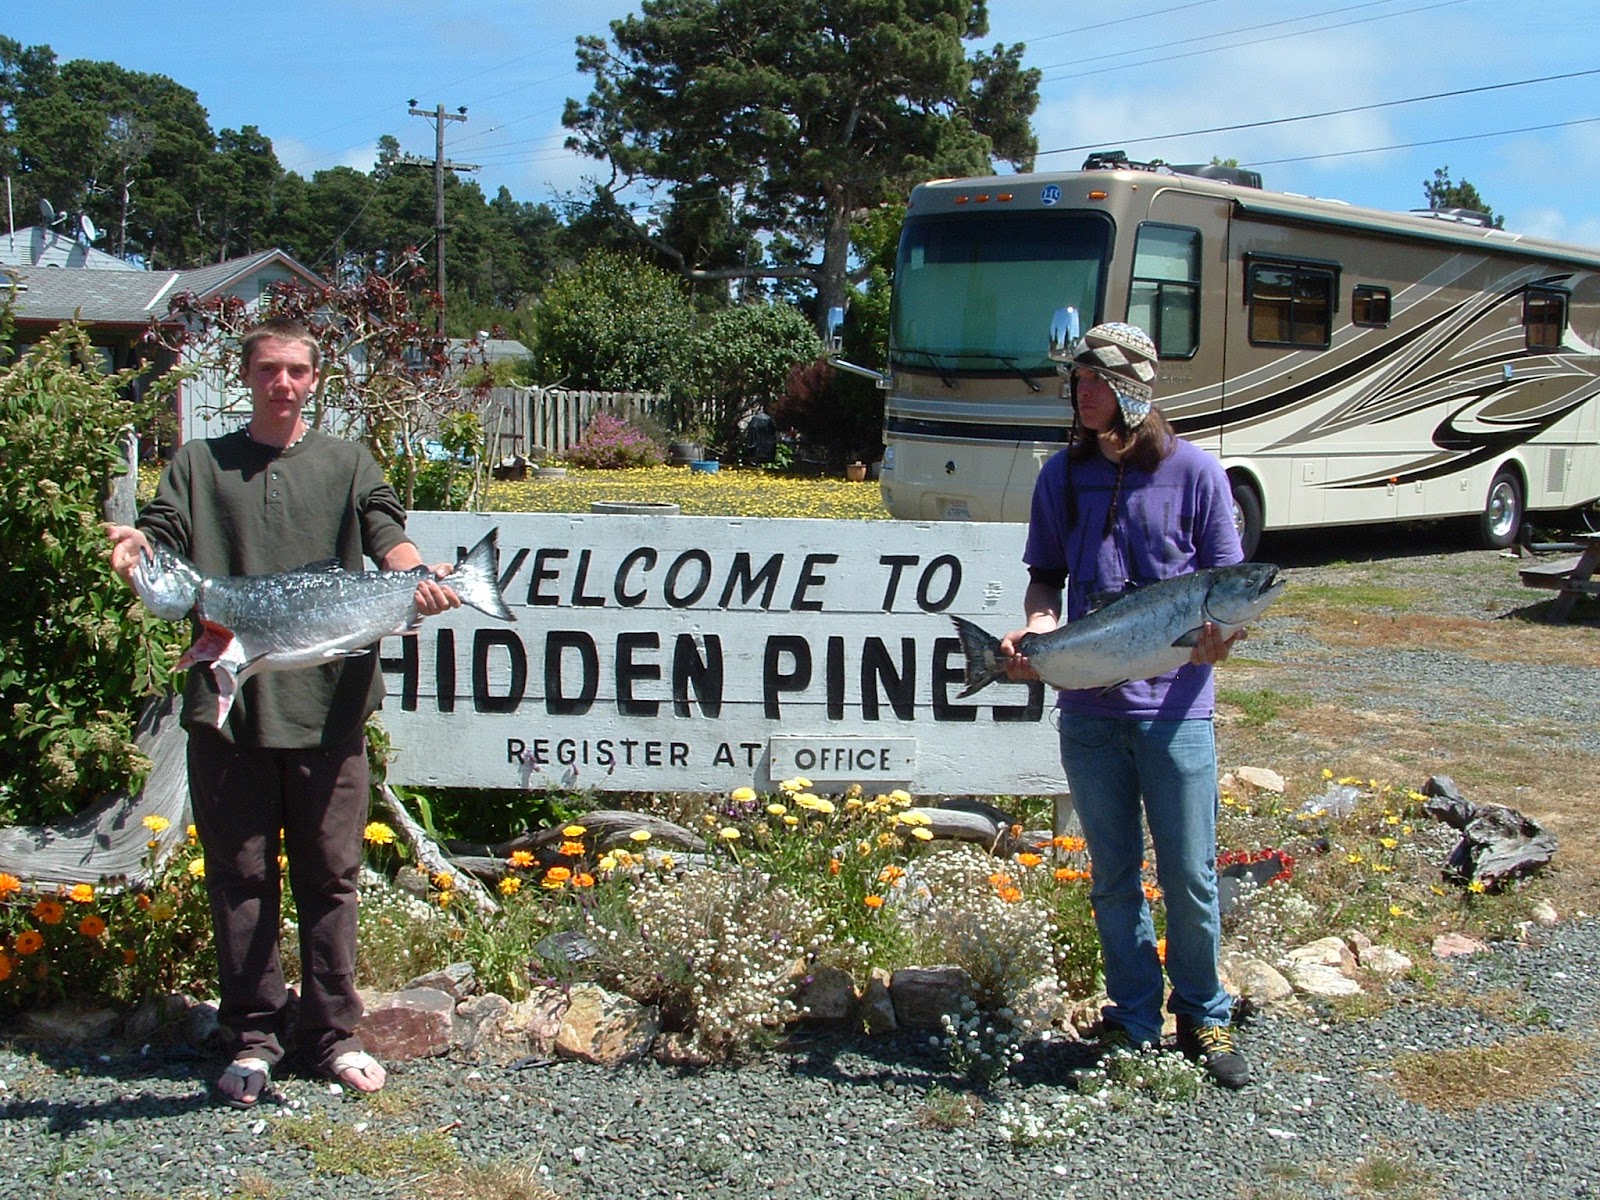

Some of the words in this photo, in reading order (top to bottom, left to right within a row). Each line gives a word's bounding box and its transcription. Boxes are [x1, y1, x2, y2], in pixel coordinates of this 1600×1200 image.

[879, 554, 962, 613] TO
[507, 738, 690, 768] REGISTER
[712, 743, 762, 767] AT
[795, 748, 891, 771] OFFICE
